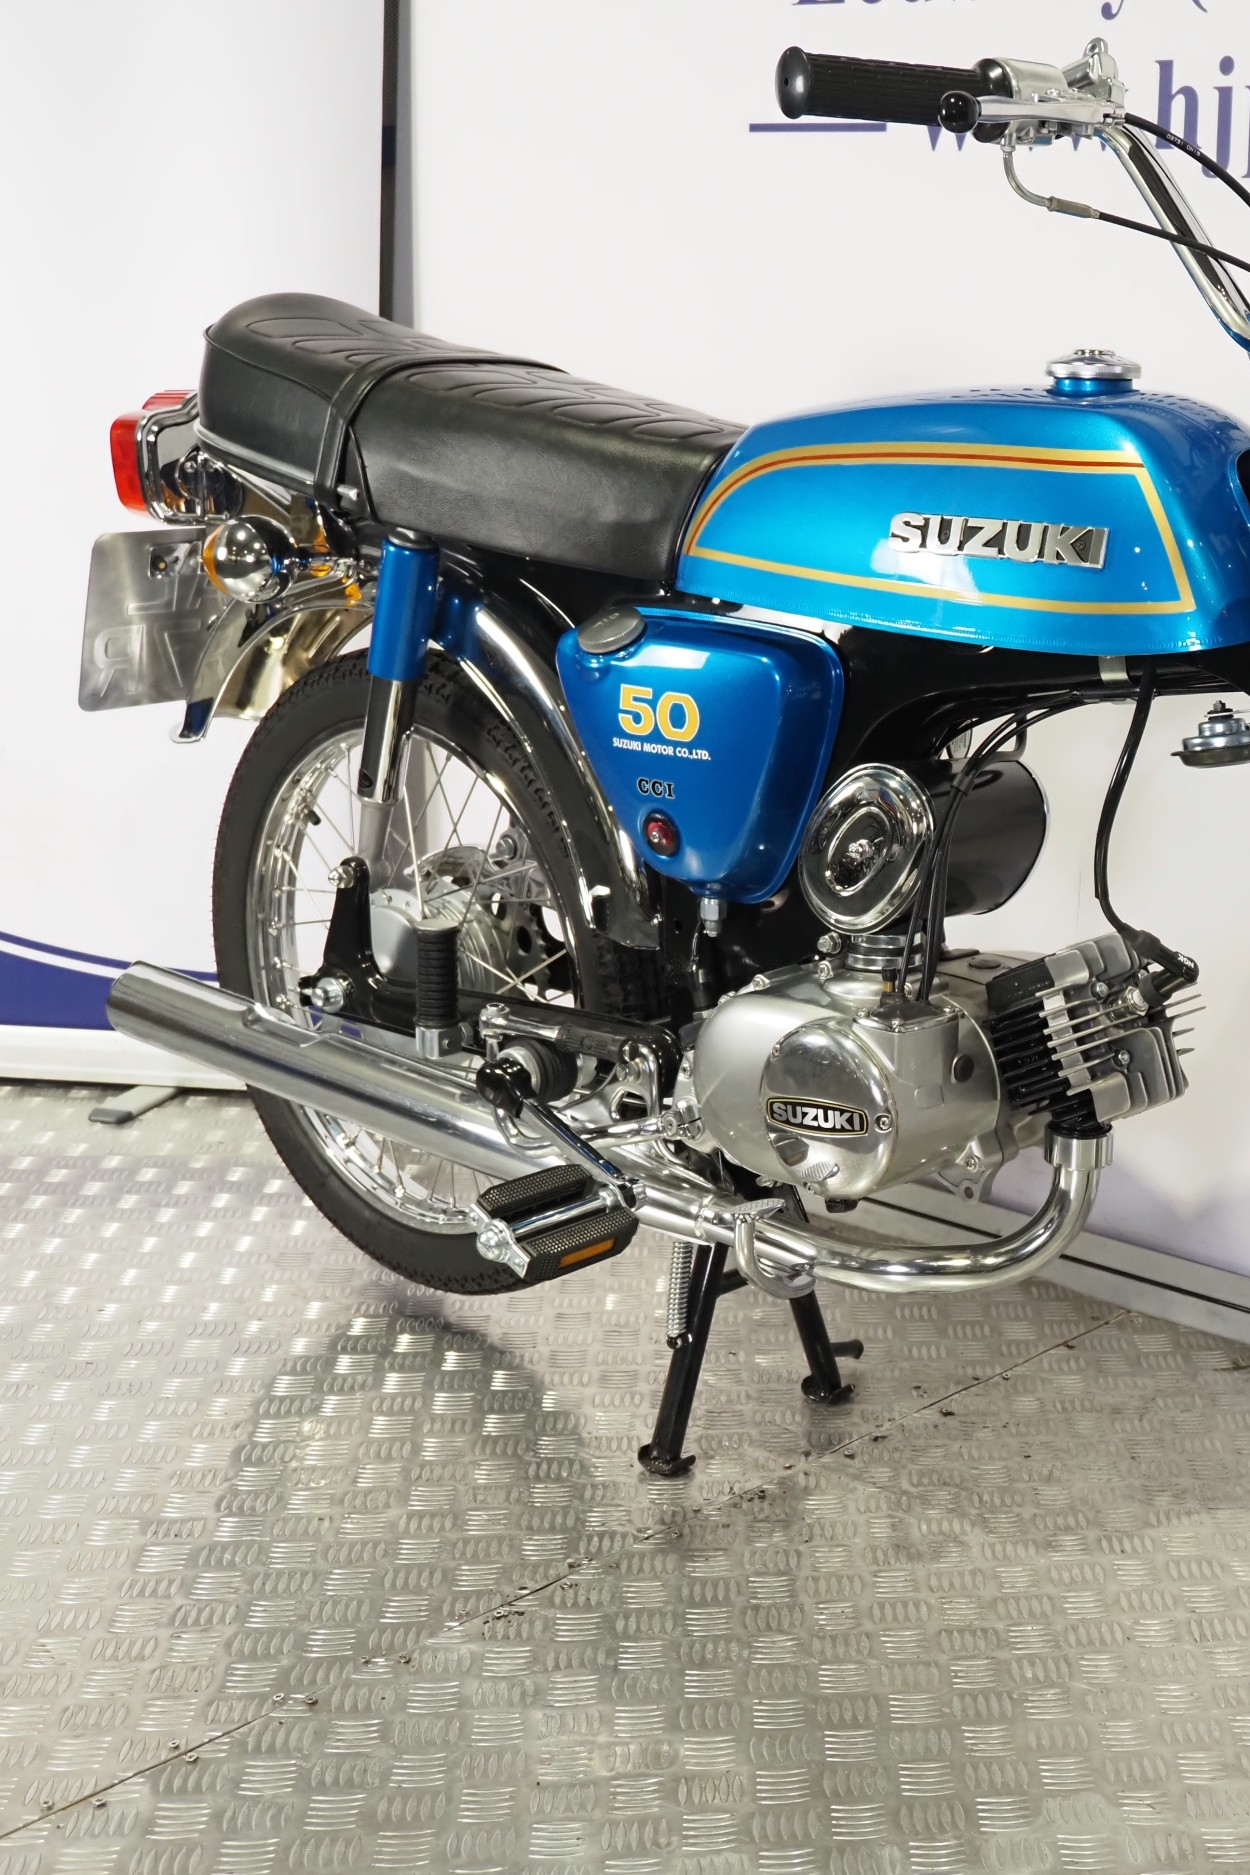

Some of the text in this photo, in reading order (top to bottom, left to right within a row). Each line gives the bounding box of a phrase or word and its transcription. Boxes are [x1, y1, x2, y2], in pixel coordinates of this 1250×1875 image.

[888, 511, 1111, 569] SUZUKI
[618, 683, 700, 742] 50
[612, 737, 642, 751] SUZUKI
[643, 742, 675, 756] MOTOR
[637, 778, 676, 800] CCI
[1177, 953, 1195, 969] NGK
[772, 1102, 861, 1131] SUZUKI
